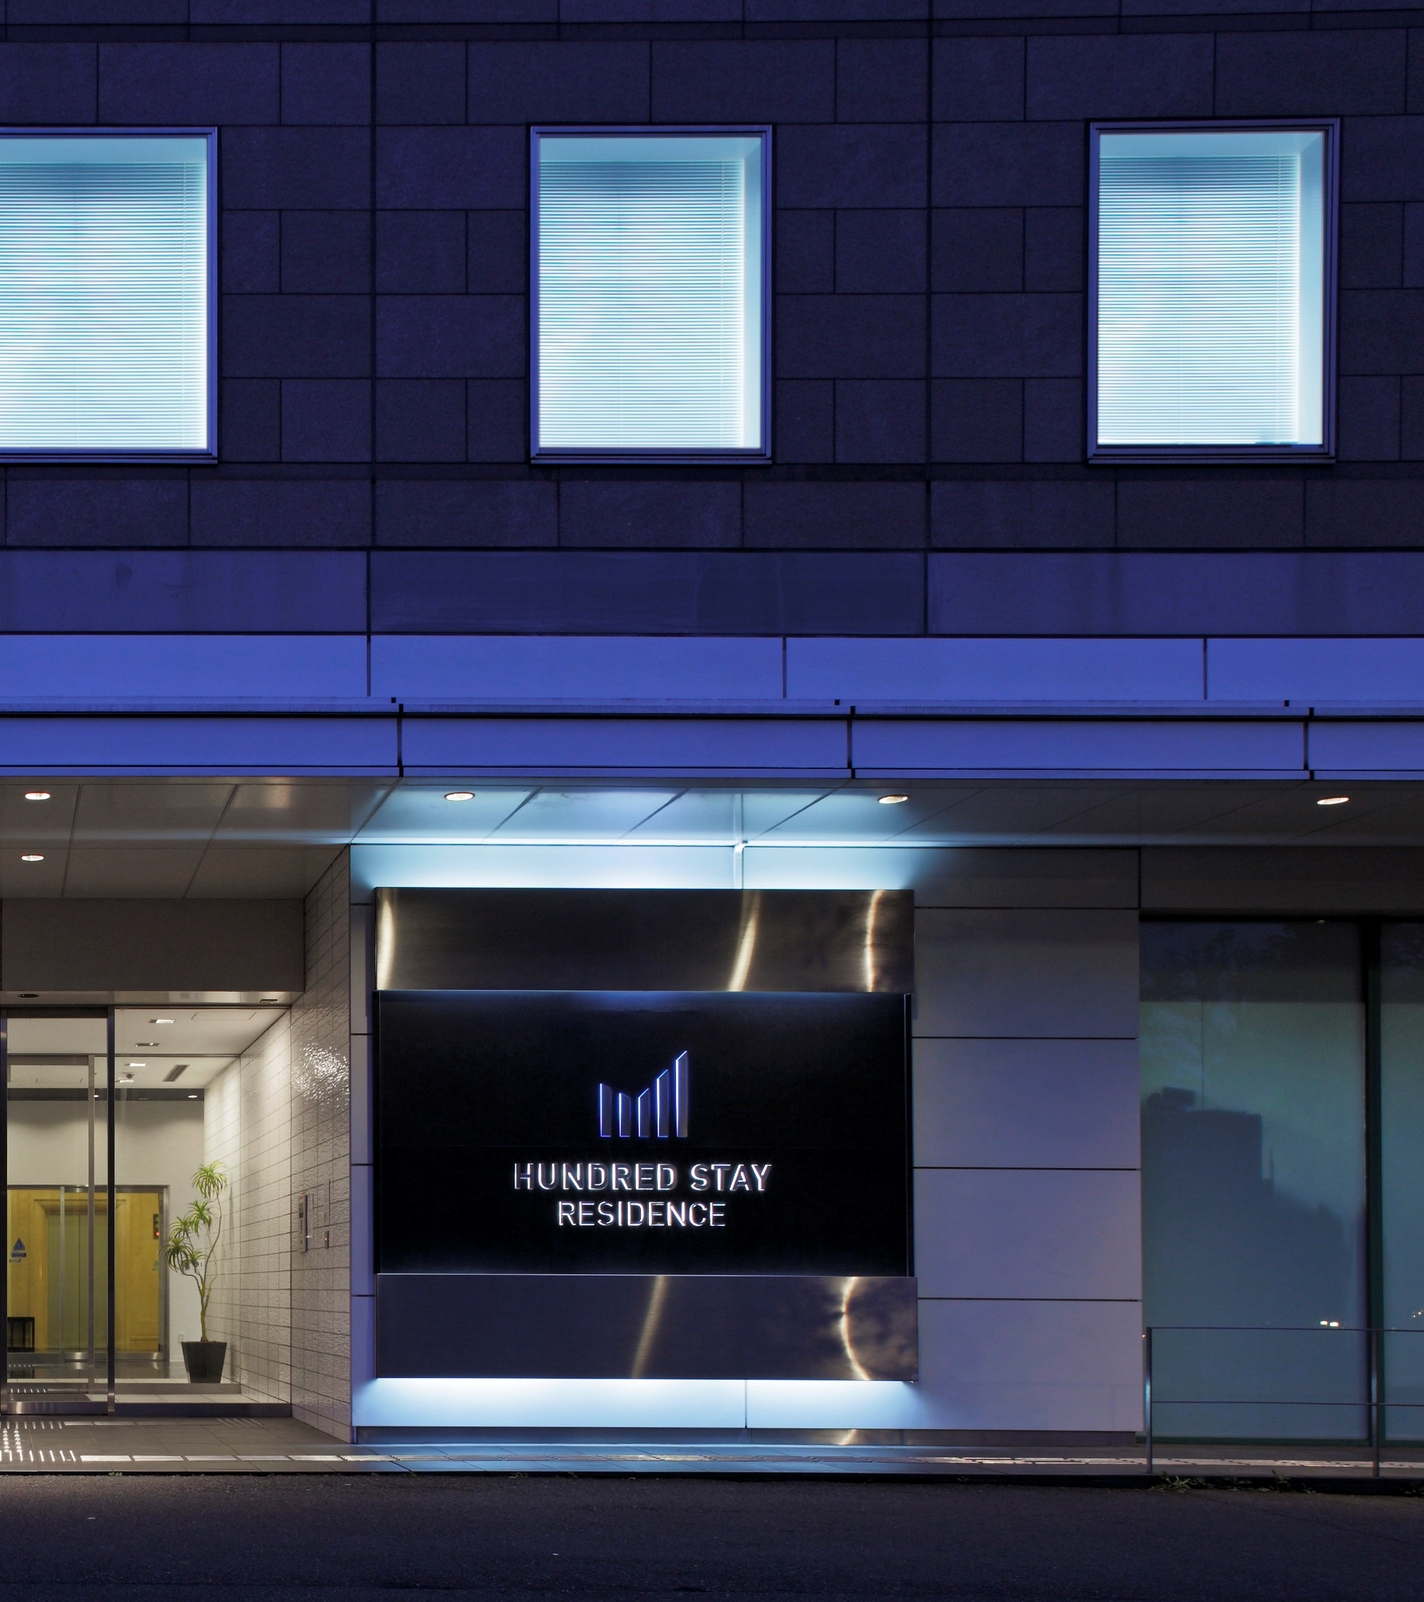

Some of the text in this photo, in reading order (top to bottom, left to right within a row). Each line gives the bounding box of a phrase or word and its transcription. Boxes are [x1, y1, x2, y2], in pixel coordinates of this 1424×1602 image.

[513, 1162, 772, 1191] HUNDRED STAY
[557, 1201, 726, 1227] RESIDENCE
